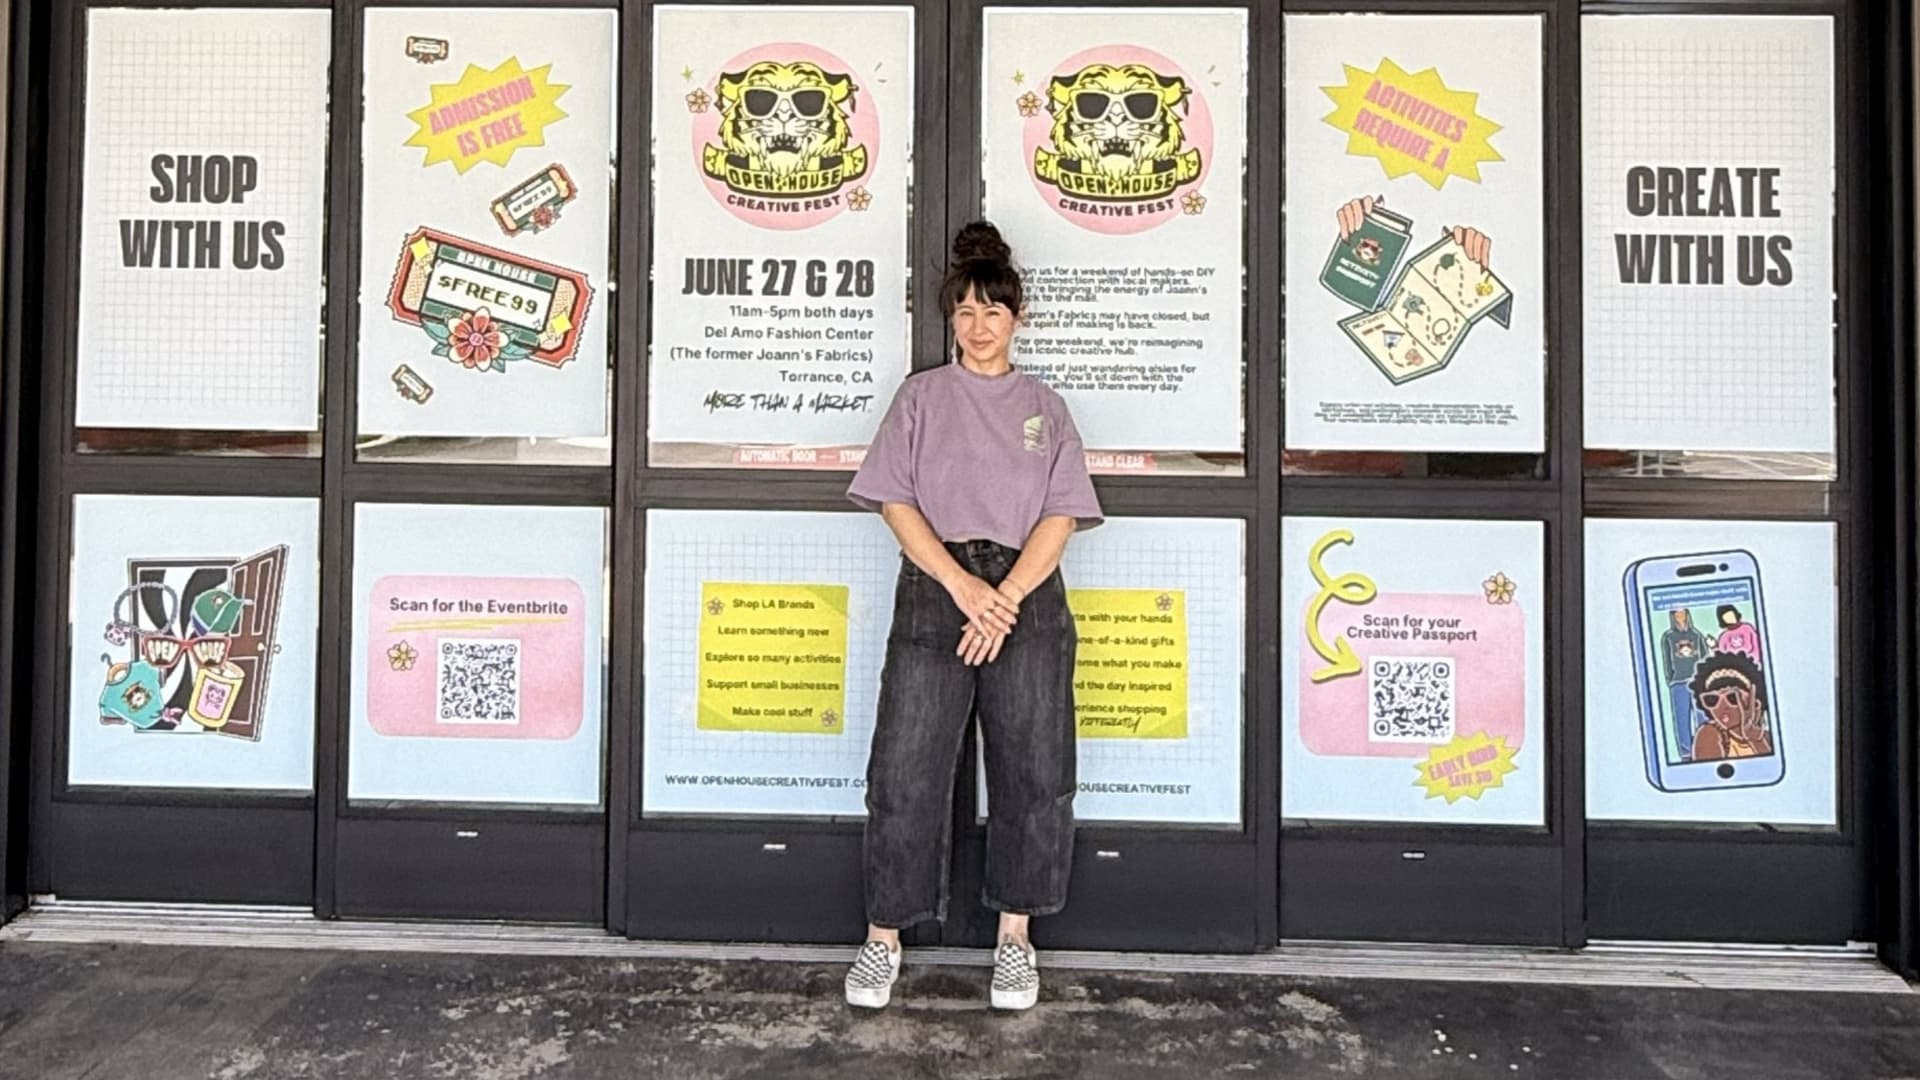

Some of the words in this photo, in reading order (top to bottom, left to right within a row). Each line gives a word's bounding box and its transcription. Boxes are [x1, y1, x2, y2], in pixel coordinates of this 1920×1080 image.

[428, 75, 536, 135] ADMISSION
[1364, 79, 1468, 144] ACTIVITIES
[455, 129, 479, 158] IS
[480, 112, 528, 147] FREE
[1352, 107, 1435, 162] REQUIRE
[1431, 147, 1451, 172] A
[150, 154, 257, 204] SHOP
[728, 169, 774, 190] OPEN
[789, 169, 841, 191] HOUSE
[1060, 172, 1107, 194] OPEN
[1121, 172, 1174, 194] HOUSE
[1626, 166, 1781, 218] CREATE
[727, 194, 800, 212] CREATIVE
[804, 194, 841, 212] FEST
[1059, 198, 1133, 216] CREATIVE
[1137, 198, 1175, 215] FEST
[119, 219, 221, 269] WITH
[232, 220, 286, 270] US
[1614, 233, 1724, 285] WITH
[1737, 235, 1793, 286] US
[682, 257, 753, 296] JUNE
[761, 258, 797, 296] 27
[805, 259, 827, 297] &
[835, 259, 875, 298] 28
[1054, 266, 1070, 276] for
[1081, 267, 1128, 276] weekend
[1130, 267, 1141, 276] of
[1197, 268, 1216, 276] DIY
[1037, 277, 1095, 285] connection
[1099, 277, 1120, 285] with
[1123, 277, 1147, 285] local
[1026, 285, 1046, 293] e're
[1049, 285, 1092, 295] bringing
[1094, 286, 1110, 294] the
[1113, 287, 1149, 296] energy
[1152, 286, 1163, 294] of
[1042, 294, 1053, 302] to
[1055, 294, 1072, 302] the
[729, 305, 801, 321] 11am-5pm
[804, 306, 836, 319] both
[840, 306, 874, 321] days
[1027, 311, 1055, 320] ann's
[1058, 311, 1097, 320] Fabrics
[1099, 312, 1121, 322] may
[1124, 312, 1149, 320] have
[1192, 312, 1211, 321] but
[1063, 320, 1074, 328] of
[1076, 320, 1114, 331] making
[1117, 320, 1126, 329] is
[704, 326, 727, 338] Del
[730, 327, 763, 339] Amo
[766, 327, 822, 340] Fashion
[825, 327, 874, 340] Center
[1034, 338, 1053, 346] one
[1109, 338, 1138, 346] we're
[670, 347, 702, 361] (The
[705, 347, 753, 361] former
[756, 349, 813, 361] Joann's
[815, 349, 874, 363] Fabrics)
[1036, 346, 1066, 355] iconic
[1069, 347, 1112, 355] creative
[1017, 363, 1053, 372] nstead
[1055, 364, 1066, 372] of
[1067, 363, 1087, 374] just
[1090, 364, 1146, 374] wandering
[1180, 364, 1196, 373] for
[779, 370, 847, 385] Torrance,
[851, 371, 874, 383] CA
[1094, 374, 1107, 382] sit
[1110, 374, 1138, 382] down
[1142, 374, 1164, 382] with
[1166, 374, 1184, 382] the
[1098, 382, 1125, 391] them
[1127, 383, 1157, 393] every
[703, 390, 746, 414] MORE
[750, 391, 789, 413] THAN
[792, 393, 804, 414] A
[740, 449, 791, 463] AUTOMATIC
[791, 450, 817, 463] DOOR
[1116, 455, 1145, 469] CLEAR
[390, 597, 428, 612] Scan
[432, 598, 455, 612] for
[458, 600, 483, 613] the
[487, 600, 568, 614] Eventbrite
[733, 599, 759, 610] Shop
[761, 600, 775, 609] LA
[778, 600, 815, 609] Brands
[1089, 614, 1111, 622] with
[1113, 615, 1137, 624] your
[1140, 614, 1173, 623] hands
[1363, 614, 1399, 627] Scan
[1403, 615, 1424, 628] for
[1428, 617, 1462, 630] your
[718, 626, 747, 635] Learn
[750, 627, 805, 638] something
[1347, 626, 1408, 640] Creative
[1412, 628, 1477, 644] Passport
[1078, 635, 1149, 646] ne-of-a-kind
[1150, 636, 1175, 648] gifts
[705, 652, 745, 663] Explore
[747, 654, 760, 662] so
[762, 655, 790, 665] many
[793, 654, 841, 664] activities
[1102, 659, 1128, 667] what
[1131, 660, 1151, 670] you
[1152, 660, 1182, 668] make
[706, 679, 748, 691] Support
[751, 680, 778, 690] small
[780, 680, 840, 691] businesses
[1086, 682, 1105, 690] the
[1107, 682, 1126, 692] day
[1128, 682, 1172, 692] inspired
[732, 706, 760, 716] Make
[763, 707, 785, 716] cool
[788, 707, 813, 717] stuff
[1117, 704, 1167, 716] shopping
[1078, 782, 1191, 795] OUSECREATIVEFEST
